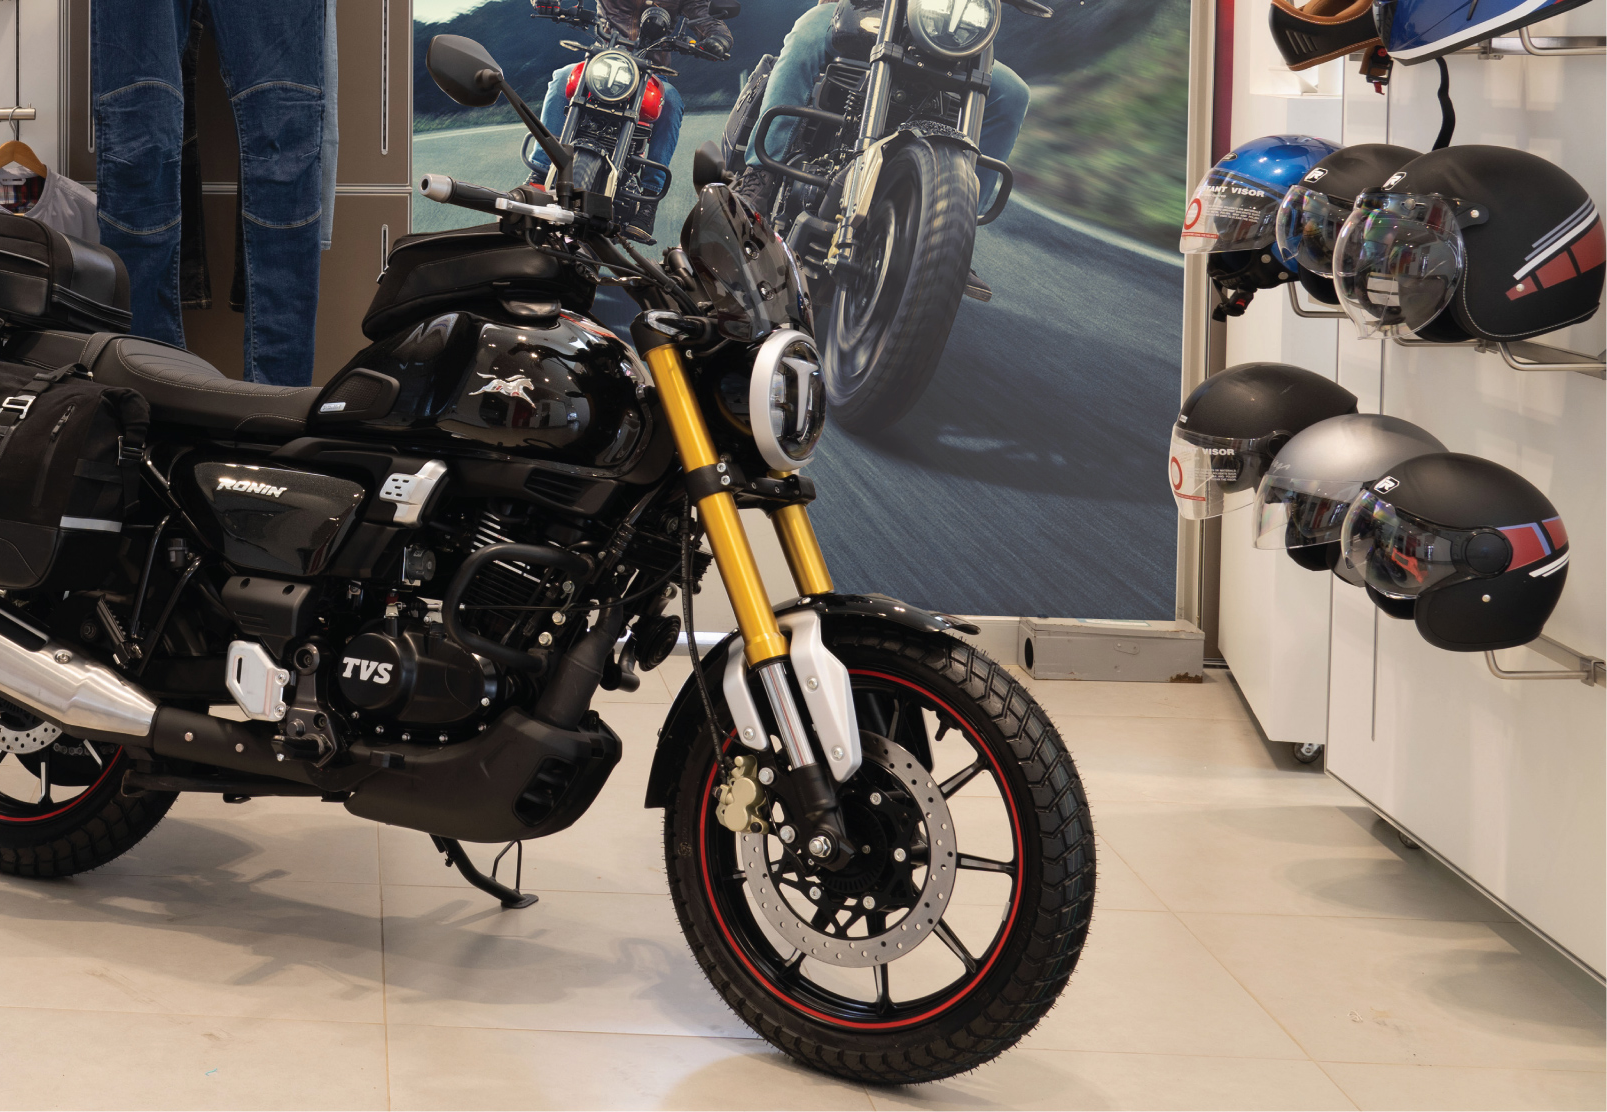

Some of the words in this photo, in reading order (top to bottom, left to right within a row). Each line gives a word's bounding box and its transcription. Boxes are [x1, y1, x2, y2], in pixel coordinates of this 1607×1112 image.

[1231, 187, 1265, 198] VISOR
[1202, 448, 1235, 456] VISOR
[216, 477, 288, 498] RONIN
[342, 656, 394, 685] TVS
